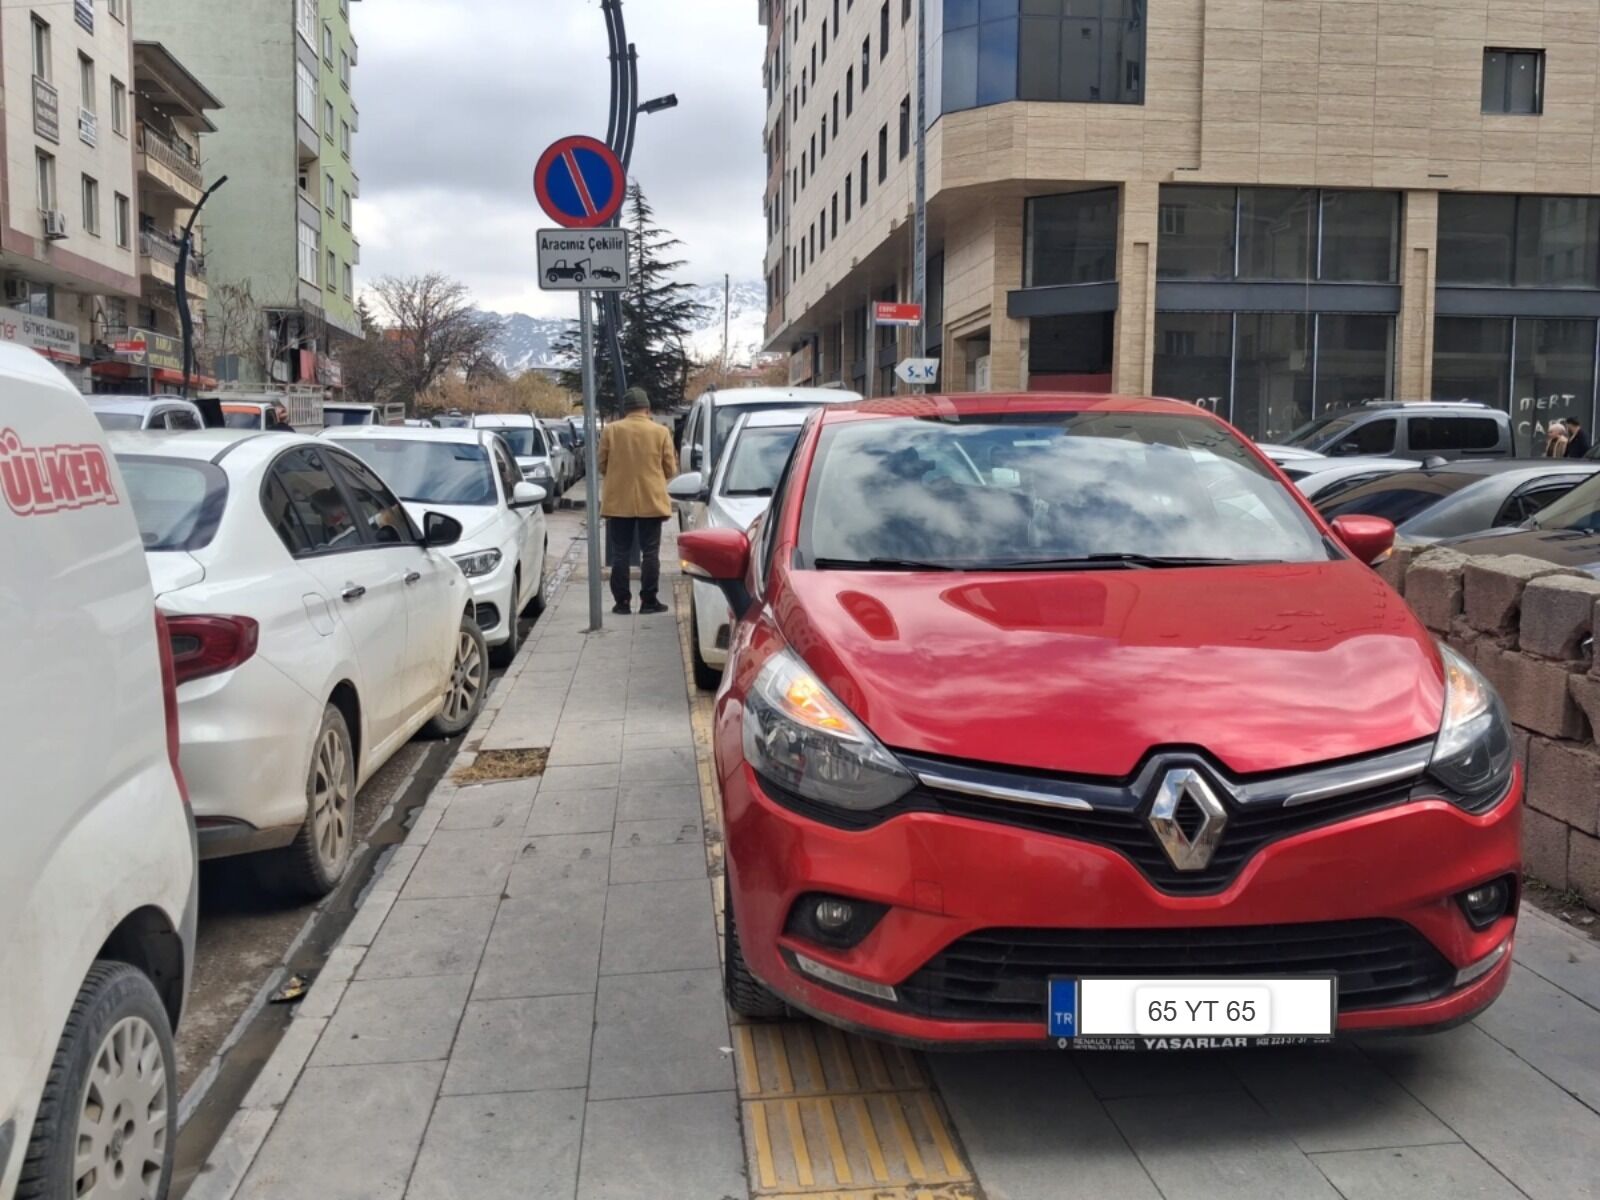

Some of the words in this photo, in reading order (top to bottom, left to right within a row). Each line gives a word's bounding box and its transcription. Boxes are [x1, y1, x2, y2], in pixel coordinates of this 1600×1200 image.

[541, 237, 585, 250] Aracınız
[588, 237, 623, 254] Çekilir
[1519, 394, 1576, 411] MERT
[0, 429, 117, 513] ÜLKER
[1055, 1012, 1073, 1025] TR
[1144, 1037, 1248, 1050] YASARLAR
